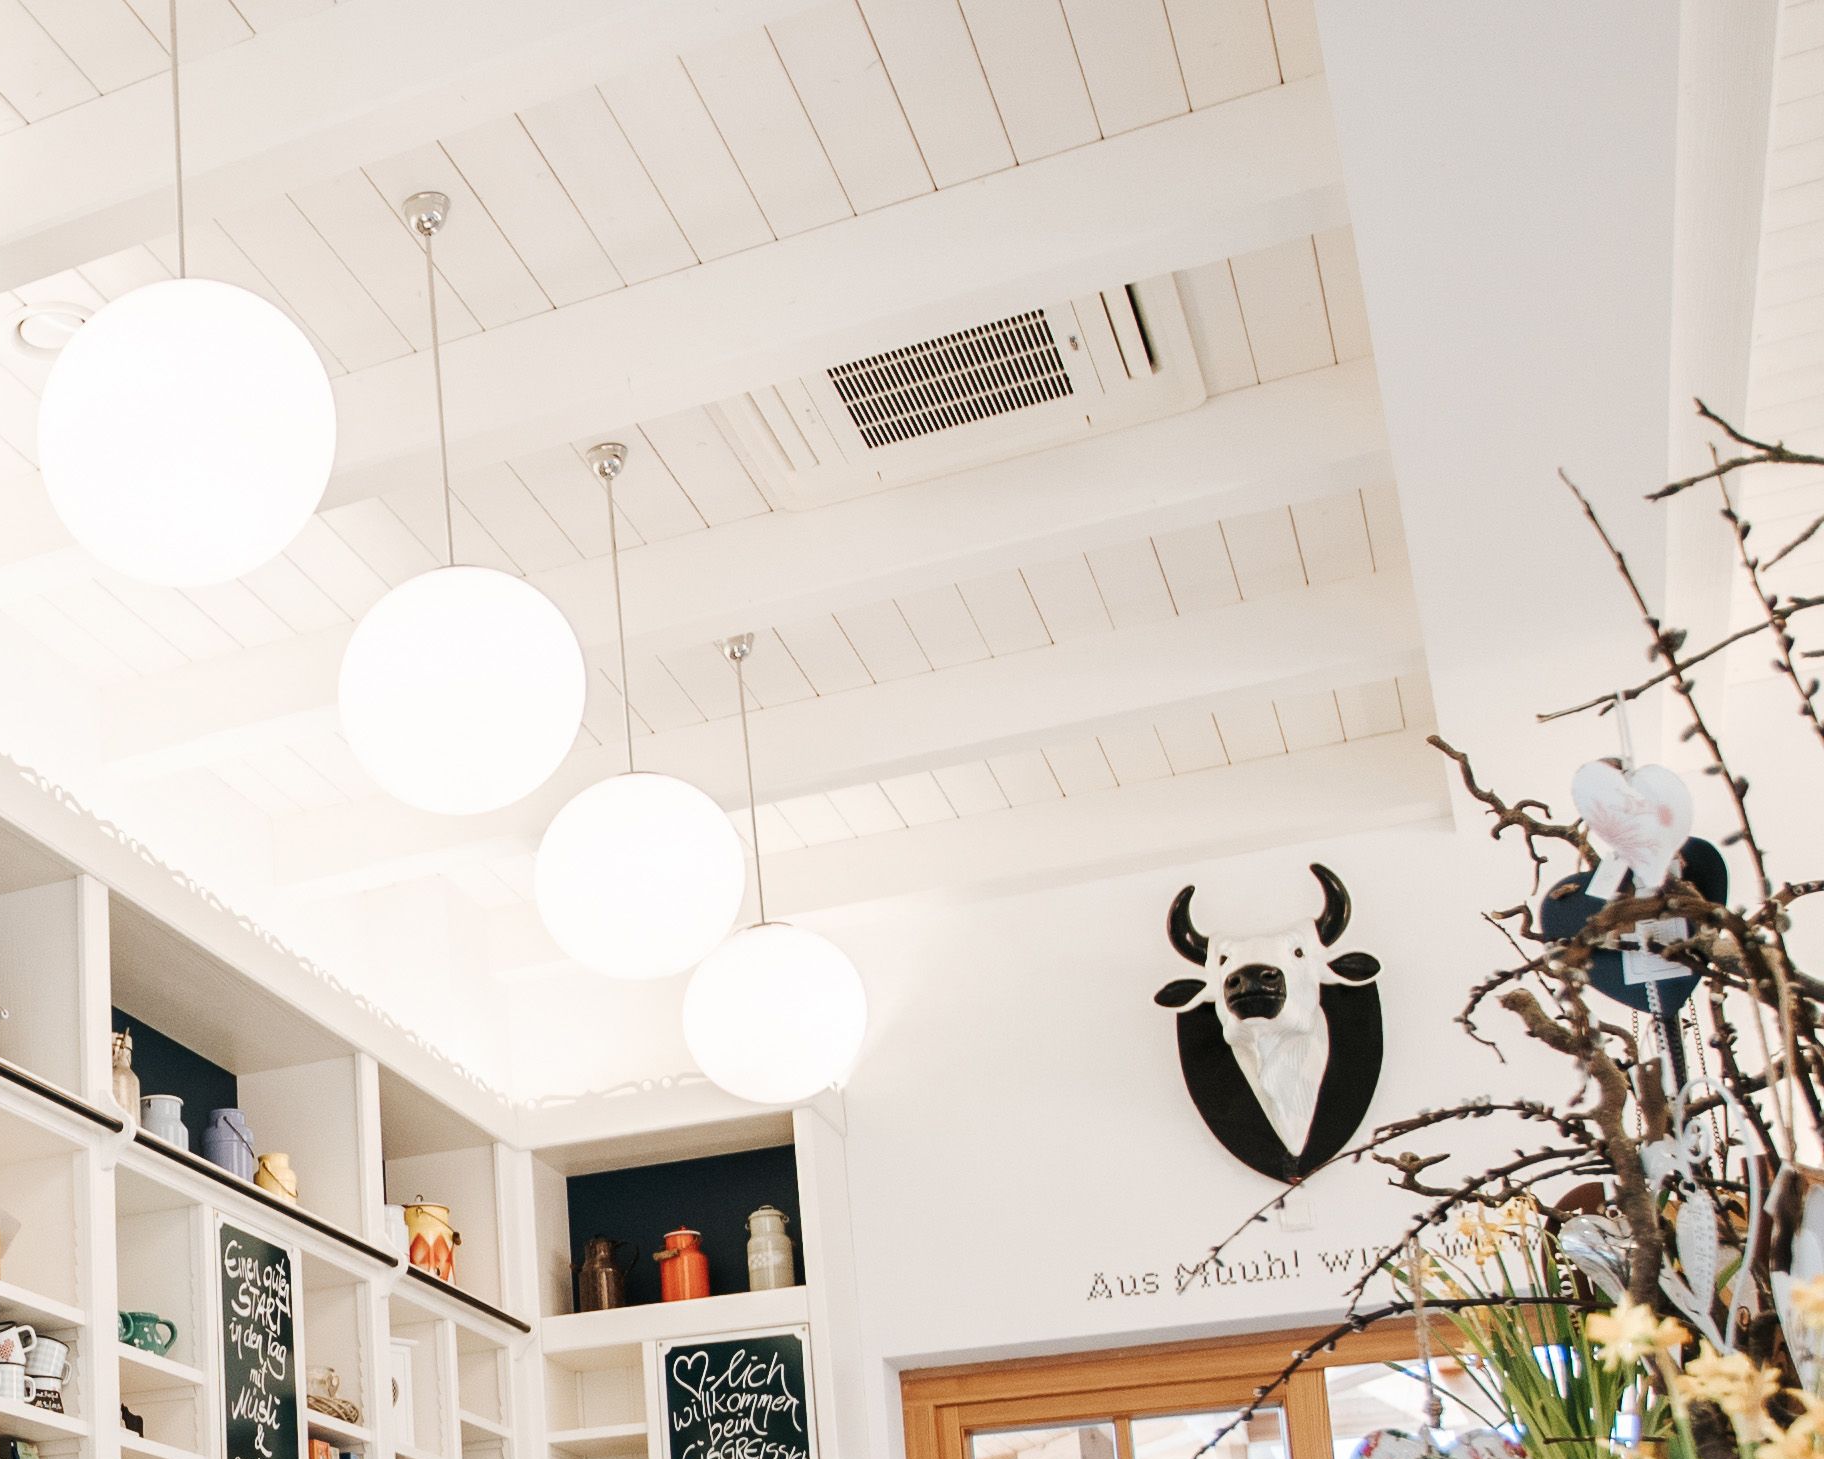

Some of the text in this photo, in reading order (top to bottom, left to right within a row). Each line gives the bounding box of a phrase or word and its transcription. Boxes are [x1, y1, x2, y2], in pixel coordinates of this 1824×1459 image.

[224, 1239, 291, 1318] Einen guten
[1087, 1271, 1159, 1301] Aus
[231, 1283, 282, 1335] START
[229, 1317, 287, 1381] in den Tag
[249, 1361, 268, 1394] mit
[232, 1386, 280, 1430] Müsli
[674, 1390, 802, 1432] willkommen
[254, 1426, 272, 1457] &
[708, 1413, 768, 1448] beim
